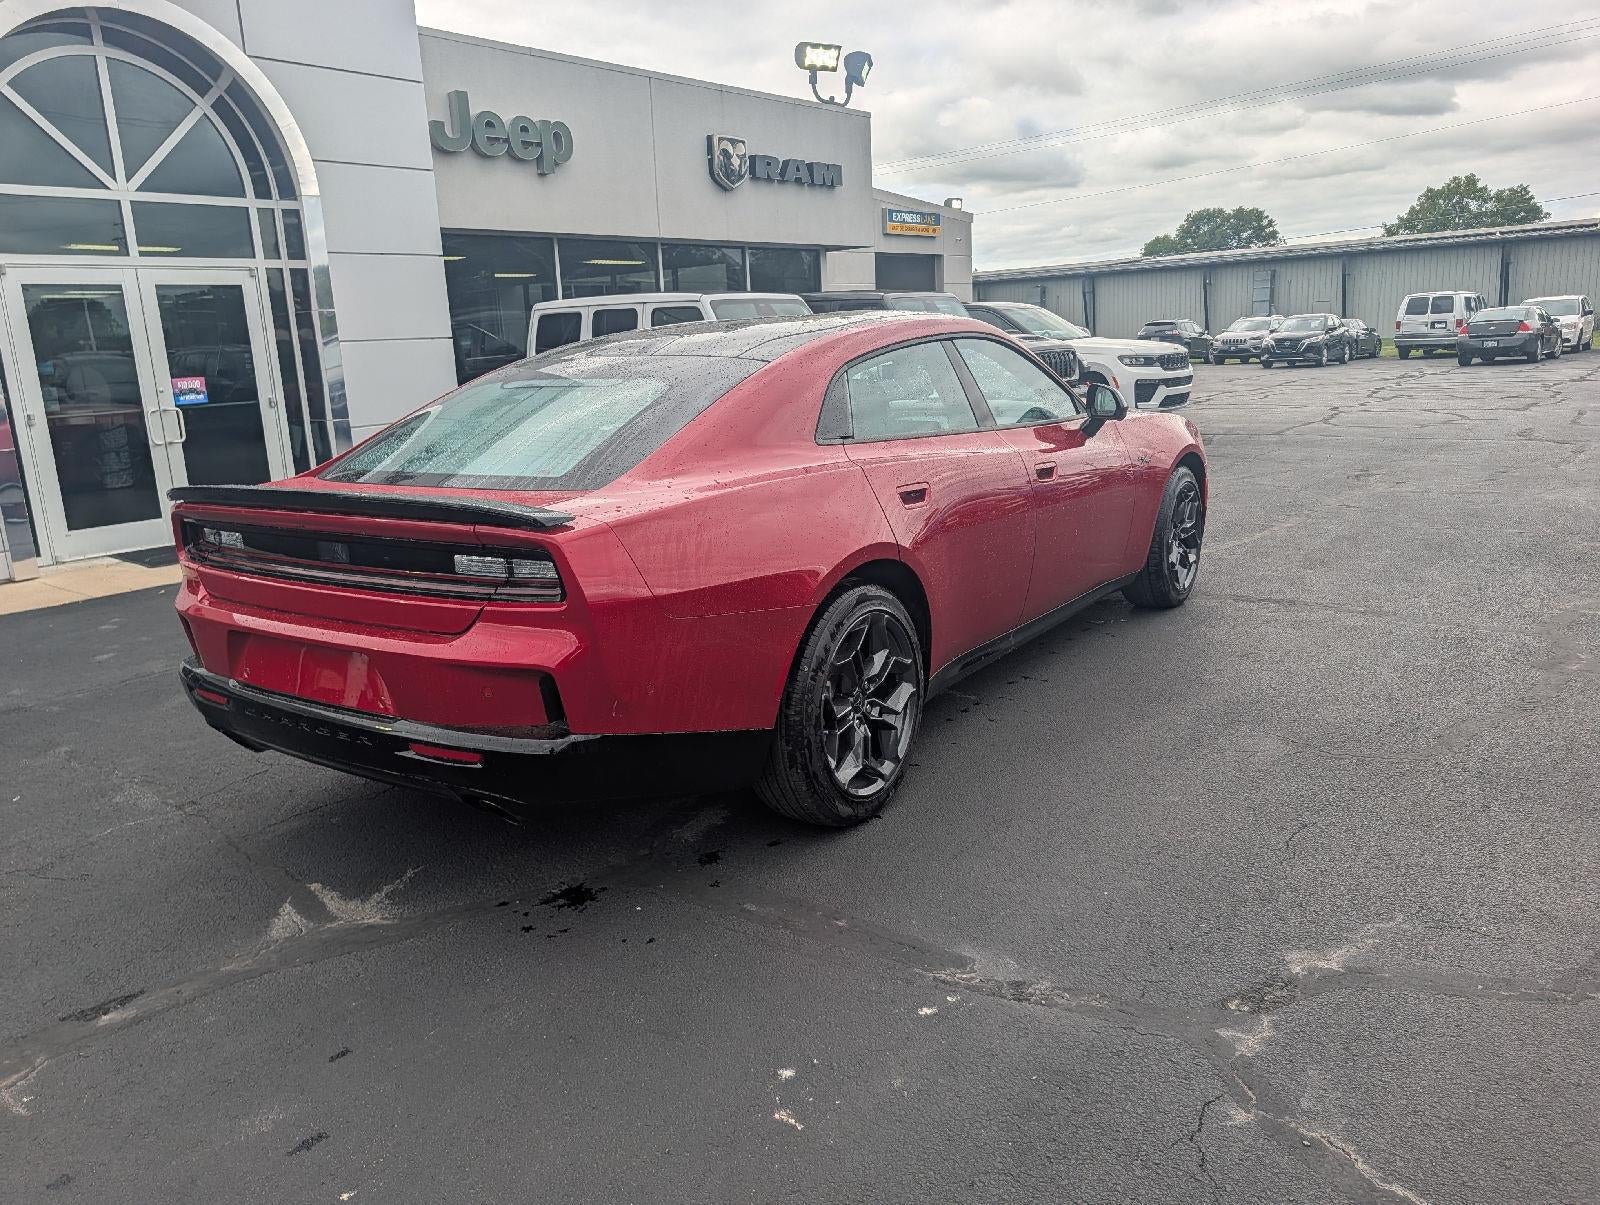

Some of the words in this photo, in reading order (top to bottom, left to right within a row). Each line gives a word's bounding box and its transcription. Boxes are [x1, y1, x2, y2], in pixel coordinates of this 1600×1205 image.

[428, 89, 574, 175] Jeep
[748, 154, 843, 187] RAM
[892, 212, 921, 223] EXPRESS
